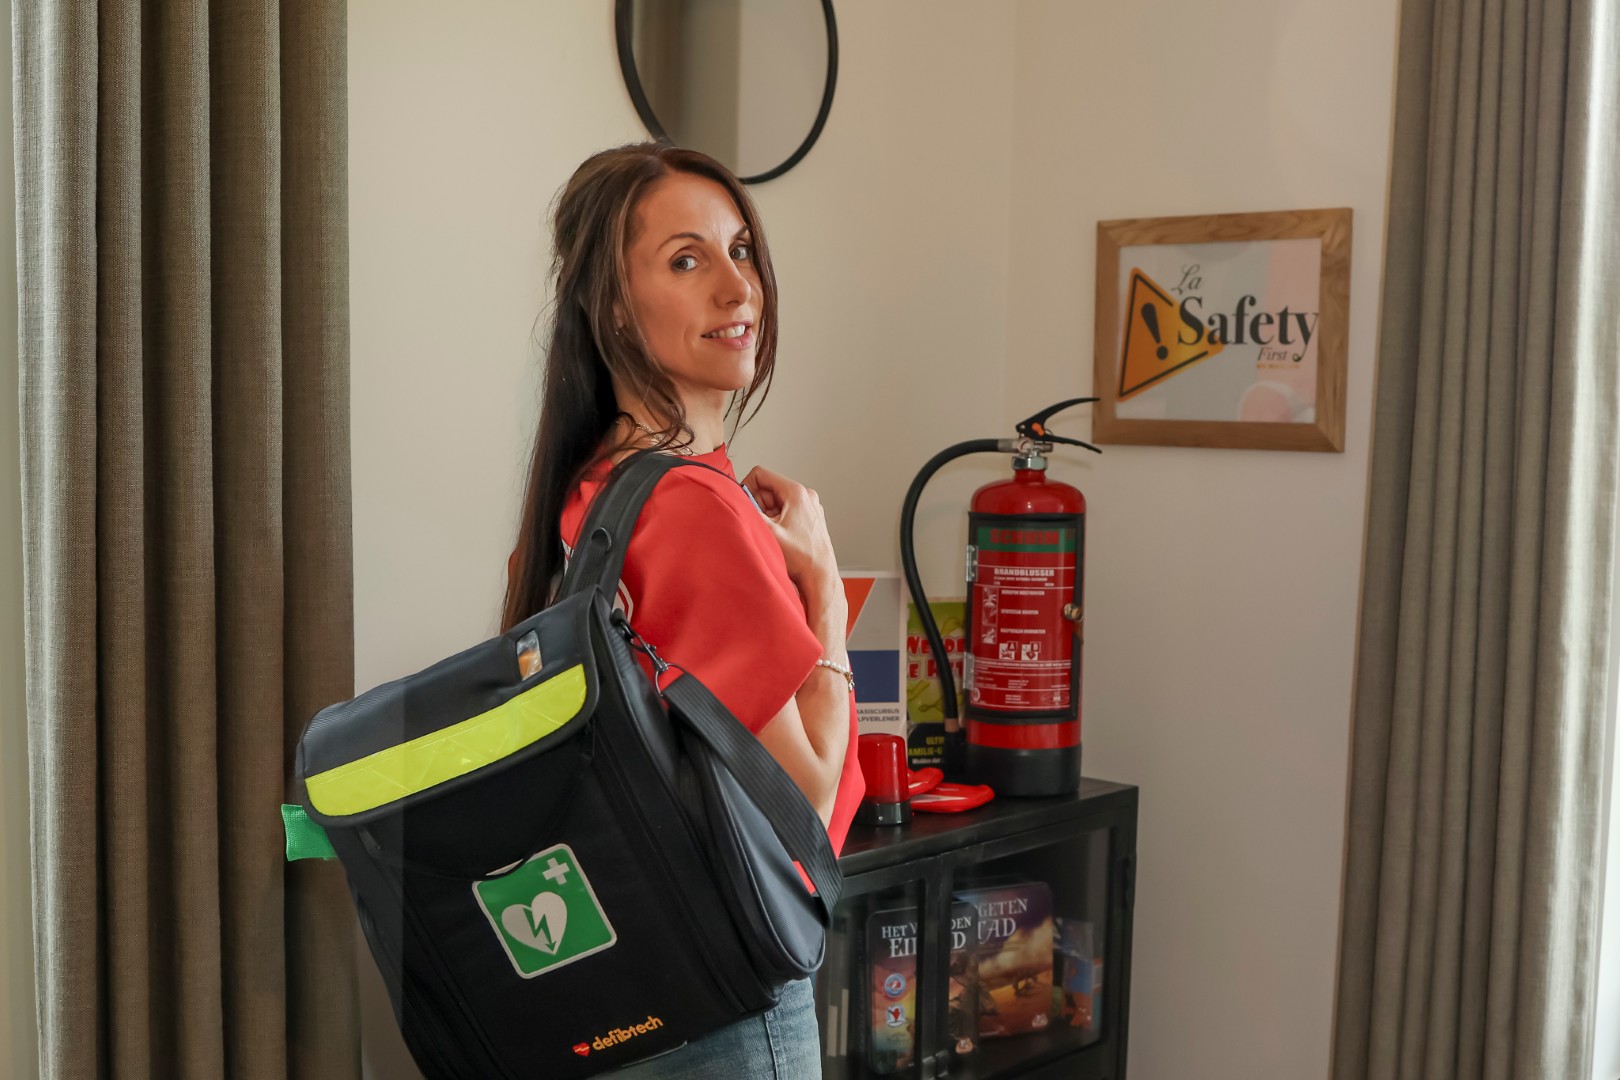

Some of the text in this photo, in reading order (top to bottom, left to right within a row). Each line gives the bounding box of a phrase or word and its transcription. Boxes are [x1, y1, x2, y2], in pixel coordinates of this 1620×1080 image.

[1170, 263, 1203, 295] La
[1177, 294, 1320, 362] Safety
[1256, 346, 1288, 362] First
[990, 528, 1060, 545] SCHUIM
[993, 567, 1055, 577] BRANDBLUSSER
[908, 746, 943, 756] AMILIE-U
[976, 897, 1029, 918] GETEN
[881, 924, 908, 939] HET
[977, 917, 1017, 945] TAD
[592, 1015, 664, 1051] defibtech
